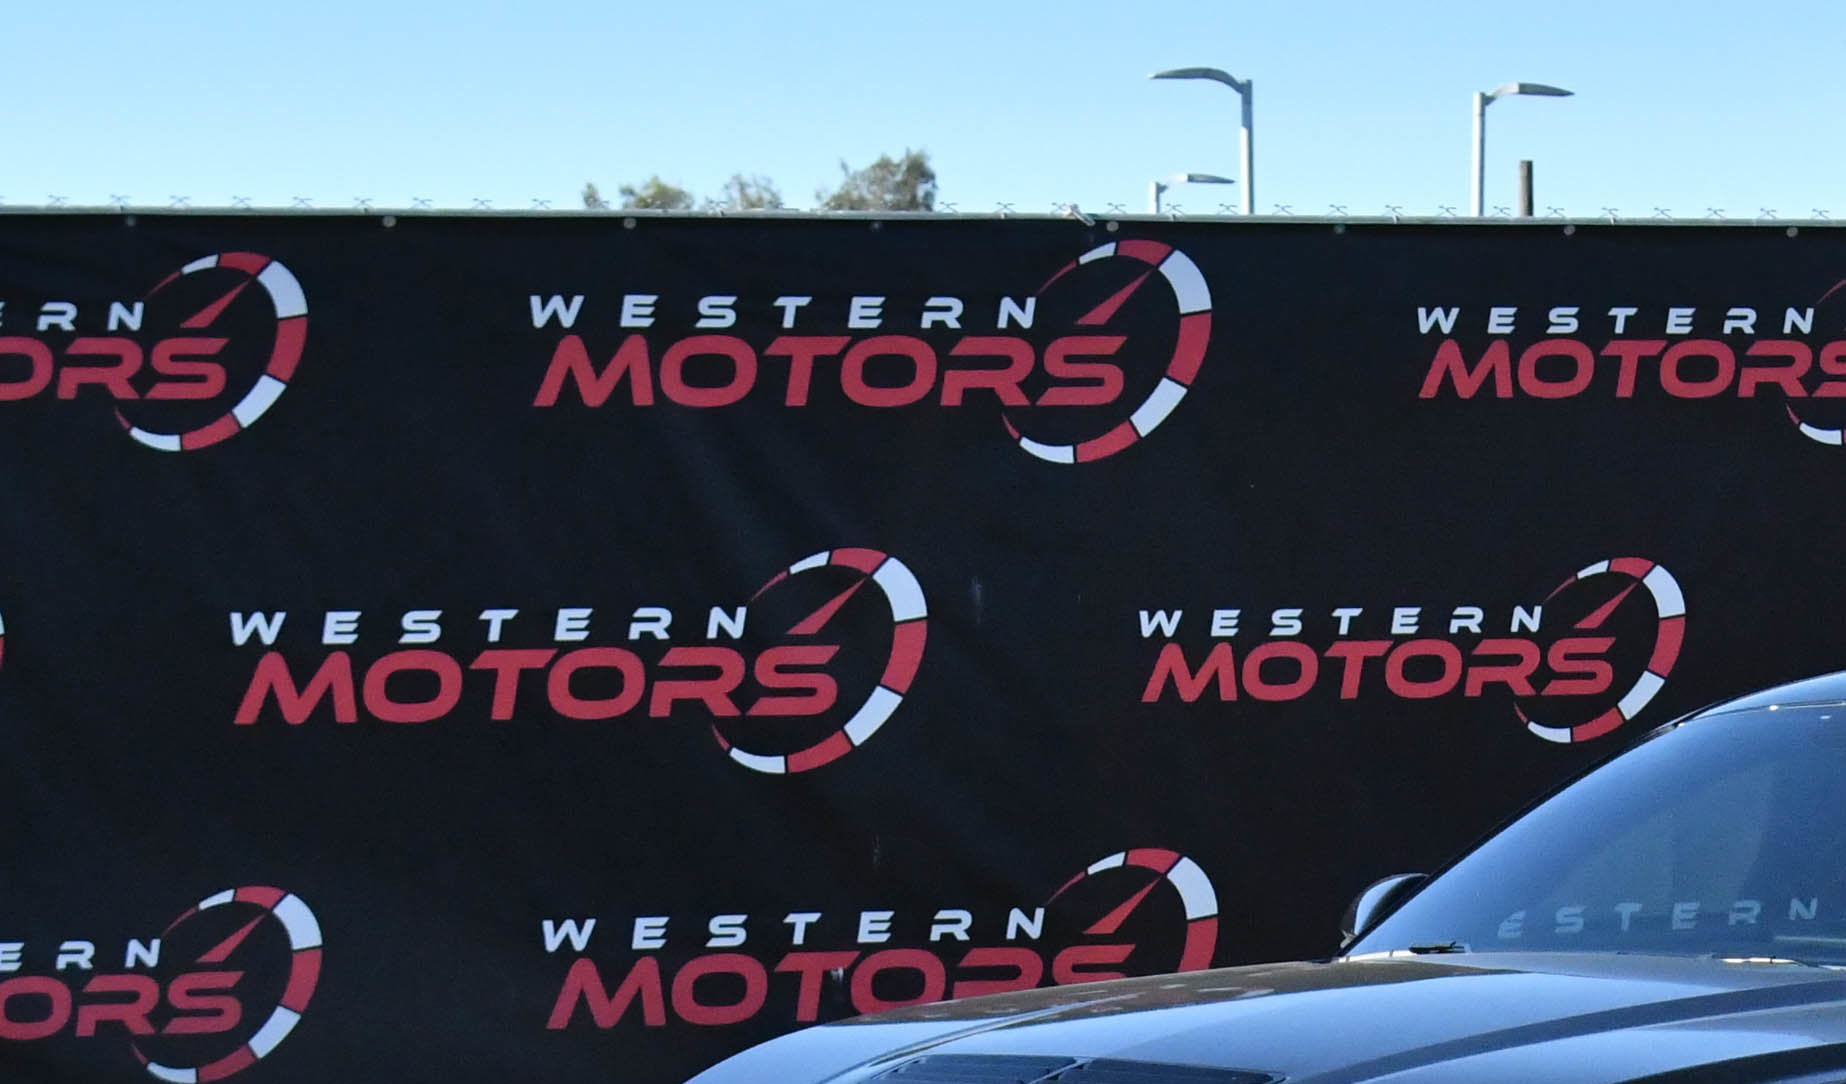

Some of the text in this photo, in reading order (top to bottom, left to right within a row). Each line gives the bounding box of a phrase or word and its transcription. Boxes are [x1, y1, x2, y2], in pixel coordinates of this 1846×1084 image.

[0, 301, 144, 331] RN
[530, 295, 1037, 329] WESTERN
[1417, 306, 1814, 335] WESTERN
[533, 335, 1127, 407] MOTORS
[230, 606, 747, 646] WESTERN
[1139, 605, 1542, 638] WESTERN
[234, 645, 841, 725] MOTORS
[1141, 637, 1617, 703] MOTORS
[542, 907, 1046, 952] WESTERN
[0, 971, 244, 1040] ORS
